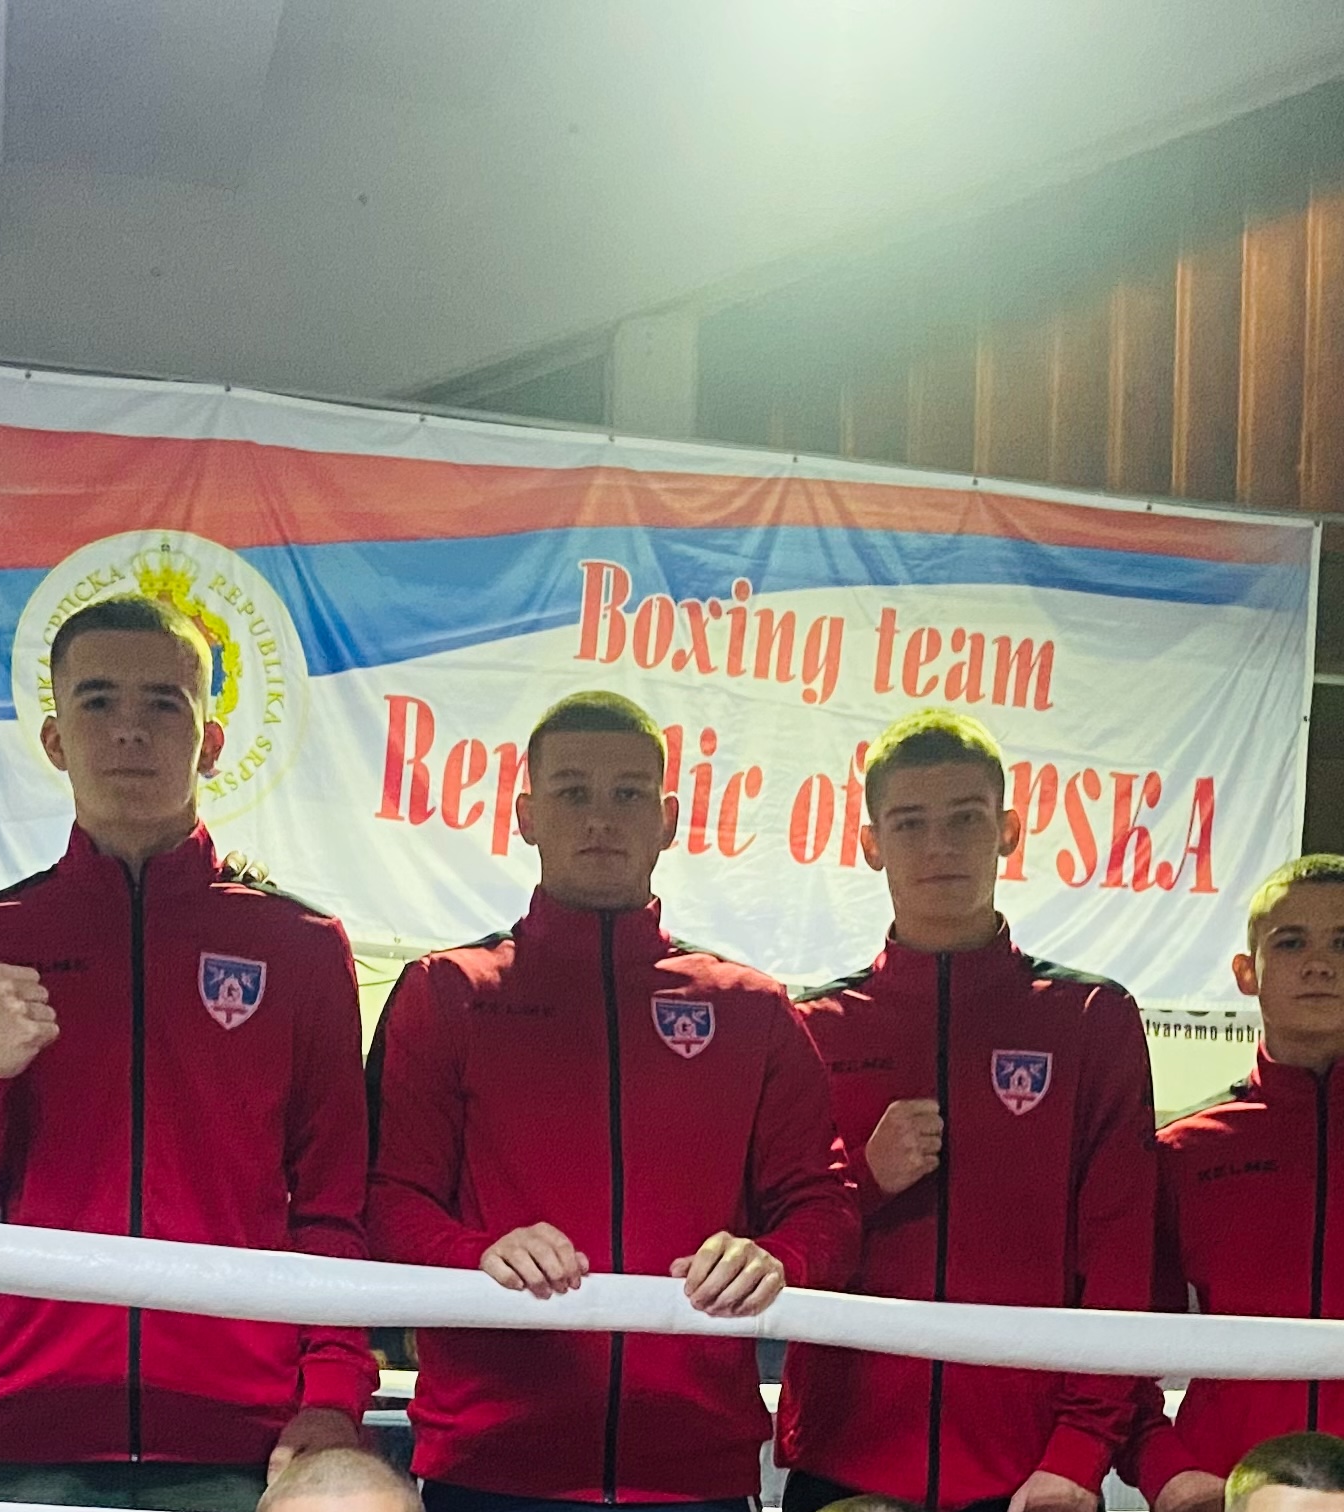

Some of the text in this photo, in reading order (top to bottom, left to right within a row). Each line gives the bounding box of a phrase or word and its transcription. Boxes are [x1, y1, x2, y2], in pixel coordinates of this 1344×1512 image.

[198, 574, 286, 802] REPUBLIKA SRPSK
[573, 559, 1056, 711] Boxing team
[374, 694, 764, 858] Replic
[999, 760, 1219, 894] PSKA
